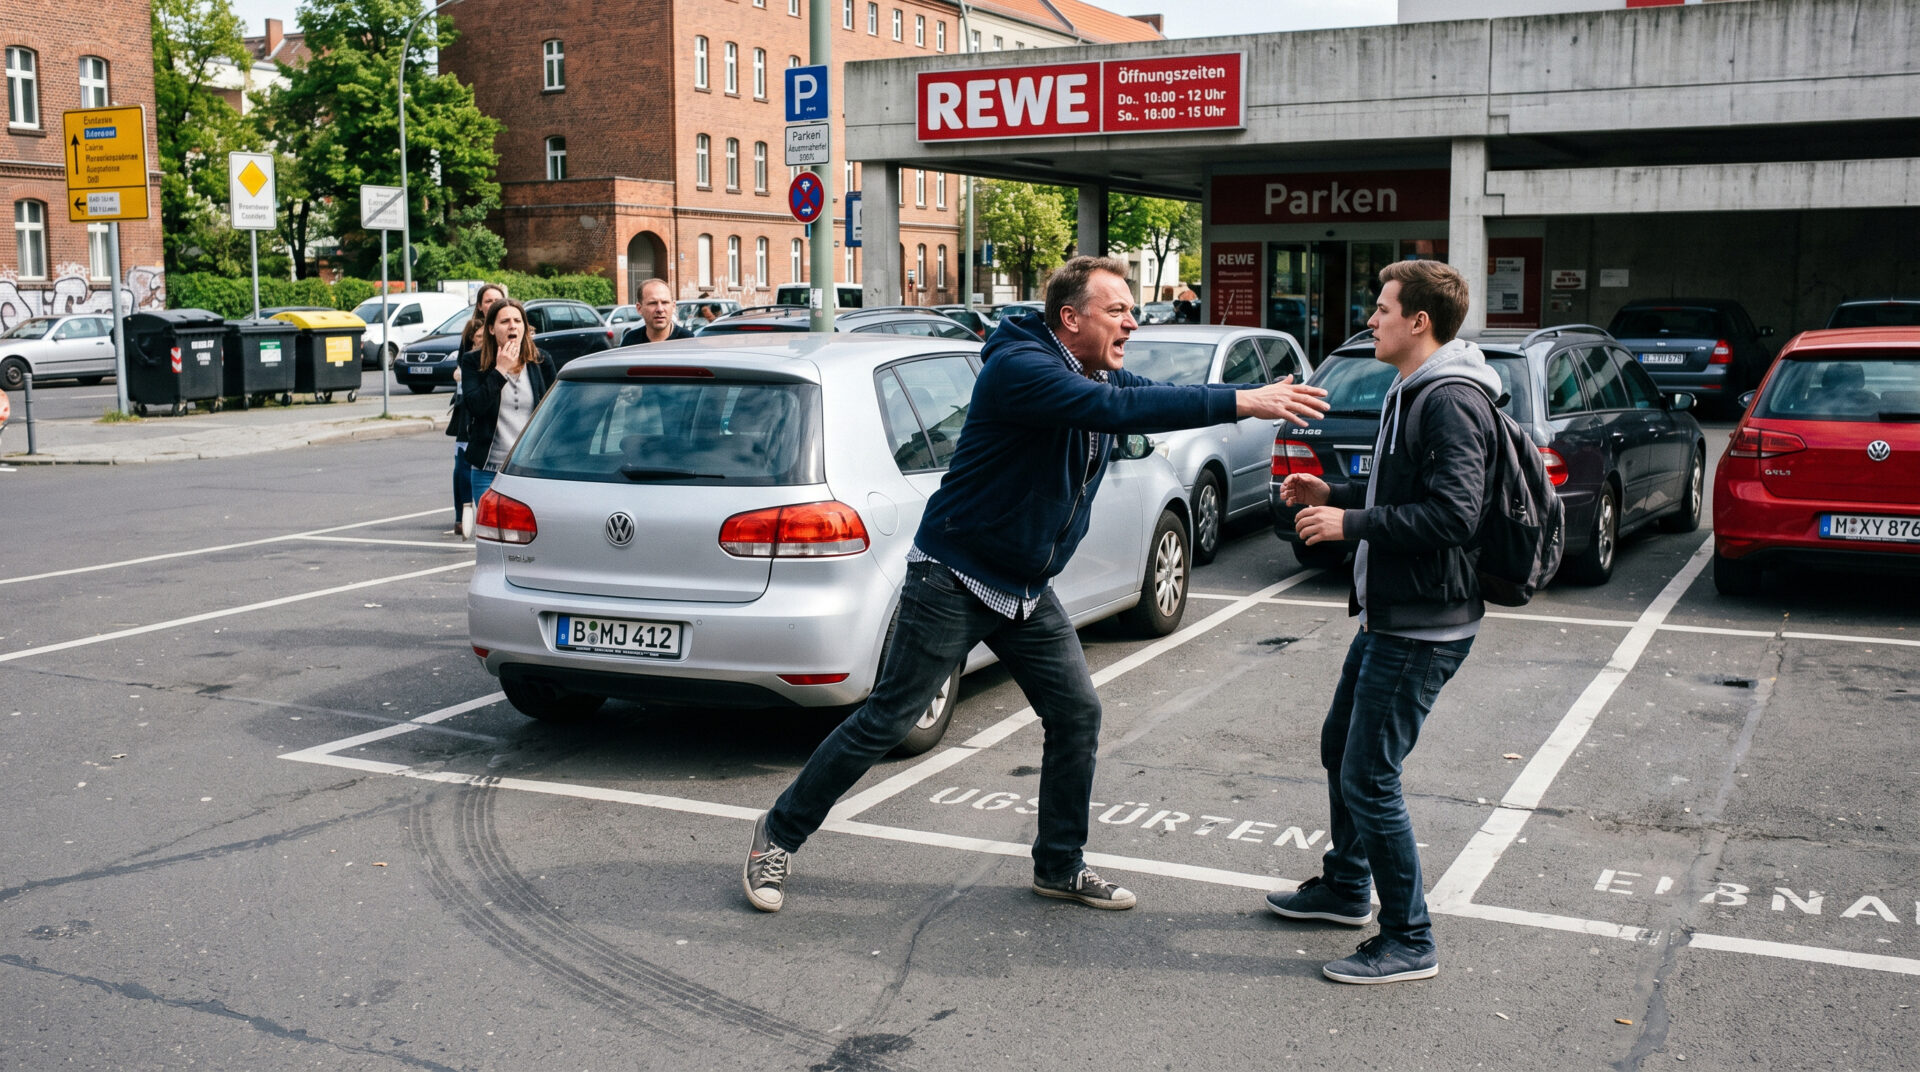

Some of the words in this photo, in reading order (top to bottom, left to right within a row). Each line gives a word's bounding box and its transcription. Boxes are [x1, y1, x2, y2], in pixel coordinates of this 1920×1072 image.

[1118, 65, 1225, 84] Öffnungszeiten
[795, 74, 817, 114] P
[928, 74, 1089, 130] REWE
[1144, 91, 1176, 103] 10:00
[1187, 89, 1201, 101] 12
[1204, 88, 1226, 100] Uhr
[1187, 106, 1201, 118] 15
[1204, 105, 1226, 117] Uhr
[1265, 181, 1398, 215] Parken
[1218, 254, 1255, 265] REWE
[1835, 518, 1848, 534] M
[1859, 519, 1884, 535] XY
[1888, 520, 1920, 537] 876
[573, 621, 586, 642] B
[600, 623, 627, 645] MJ
[632, 626, 673, 649] 412
